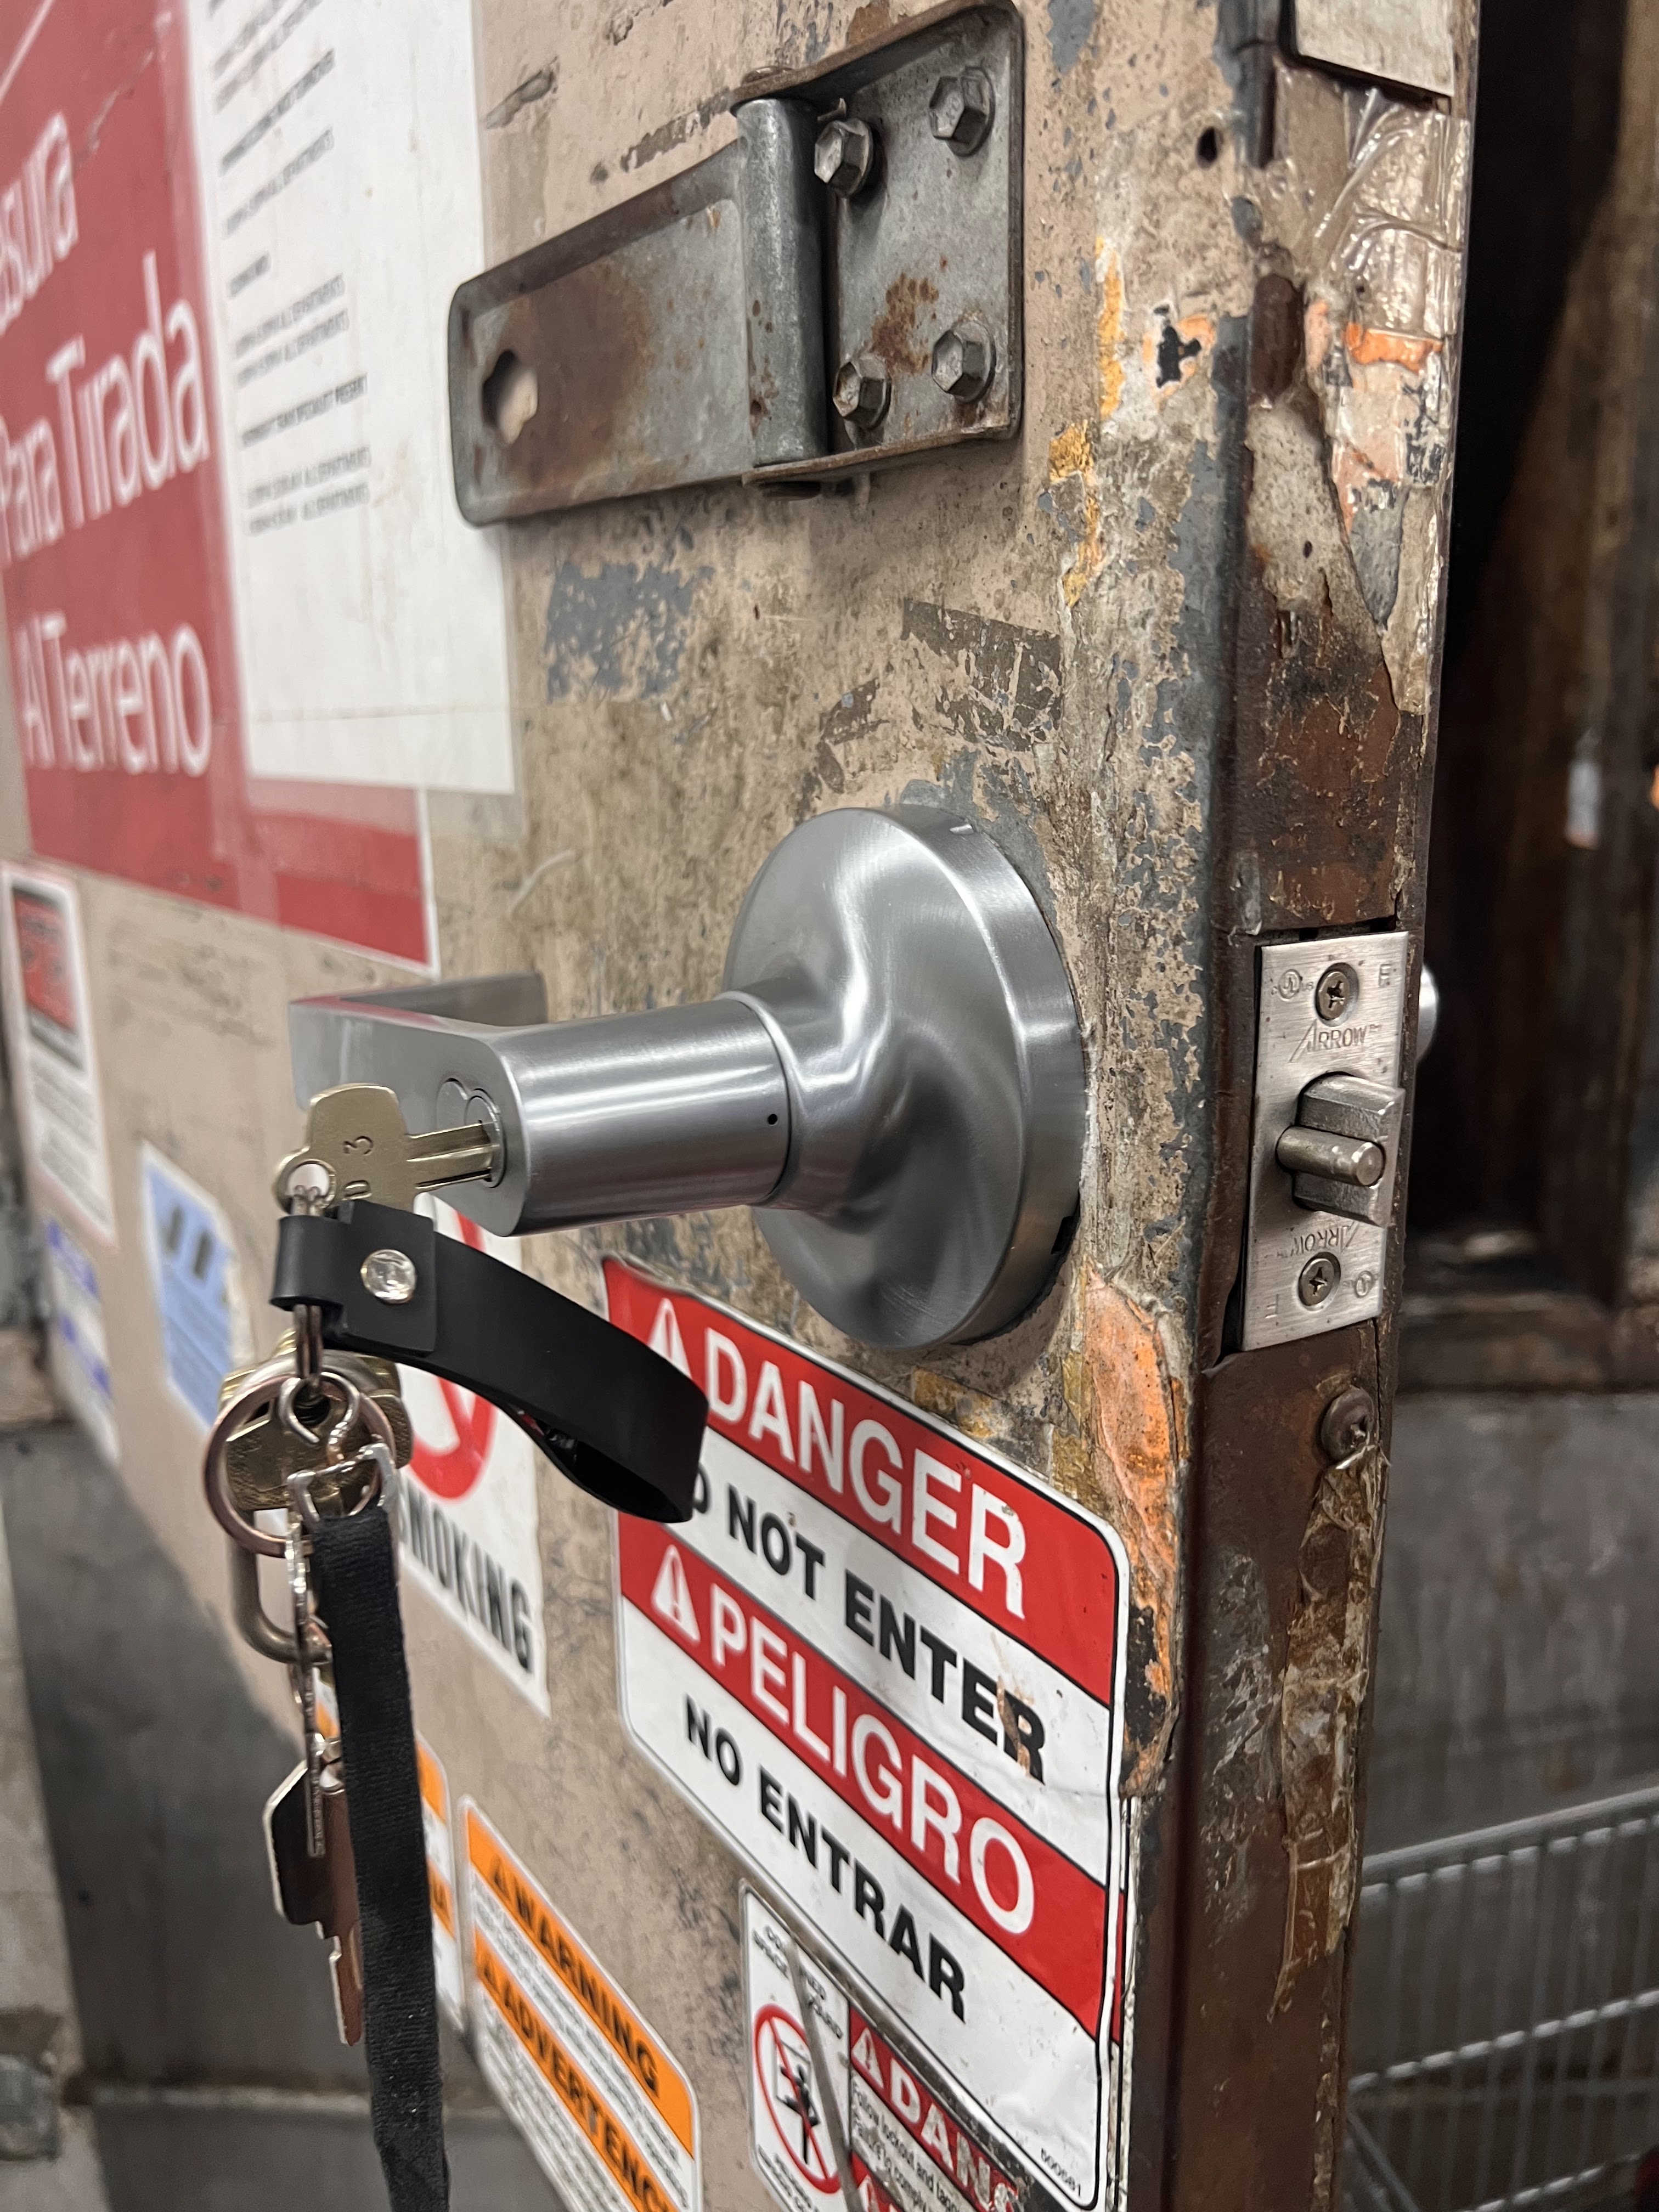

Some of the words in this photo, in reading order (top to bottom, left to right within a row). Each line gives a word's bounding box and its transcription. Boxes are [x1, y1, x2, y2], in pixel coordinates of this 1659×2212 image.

[0, 111, 78, 332] sura
[46, 250, 210, 529] Tirada
[38, 609, 213, 777] Terreno
[704, 1327, 1026, 1621] DANGER
[709, 1582, 1035, 1935] PELIGRO
[728, 1482, 826, 1601] NOT
[845, 1567, 1047, 1785] ENTER
[514, 1872, 659, 2099] WARNING
[685, 1693, 742, 1787] NO
[759, 1764, 966, 2024] ENTRAR
[500, 1980, 670, 2212] ADVERTENC
